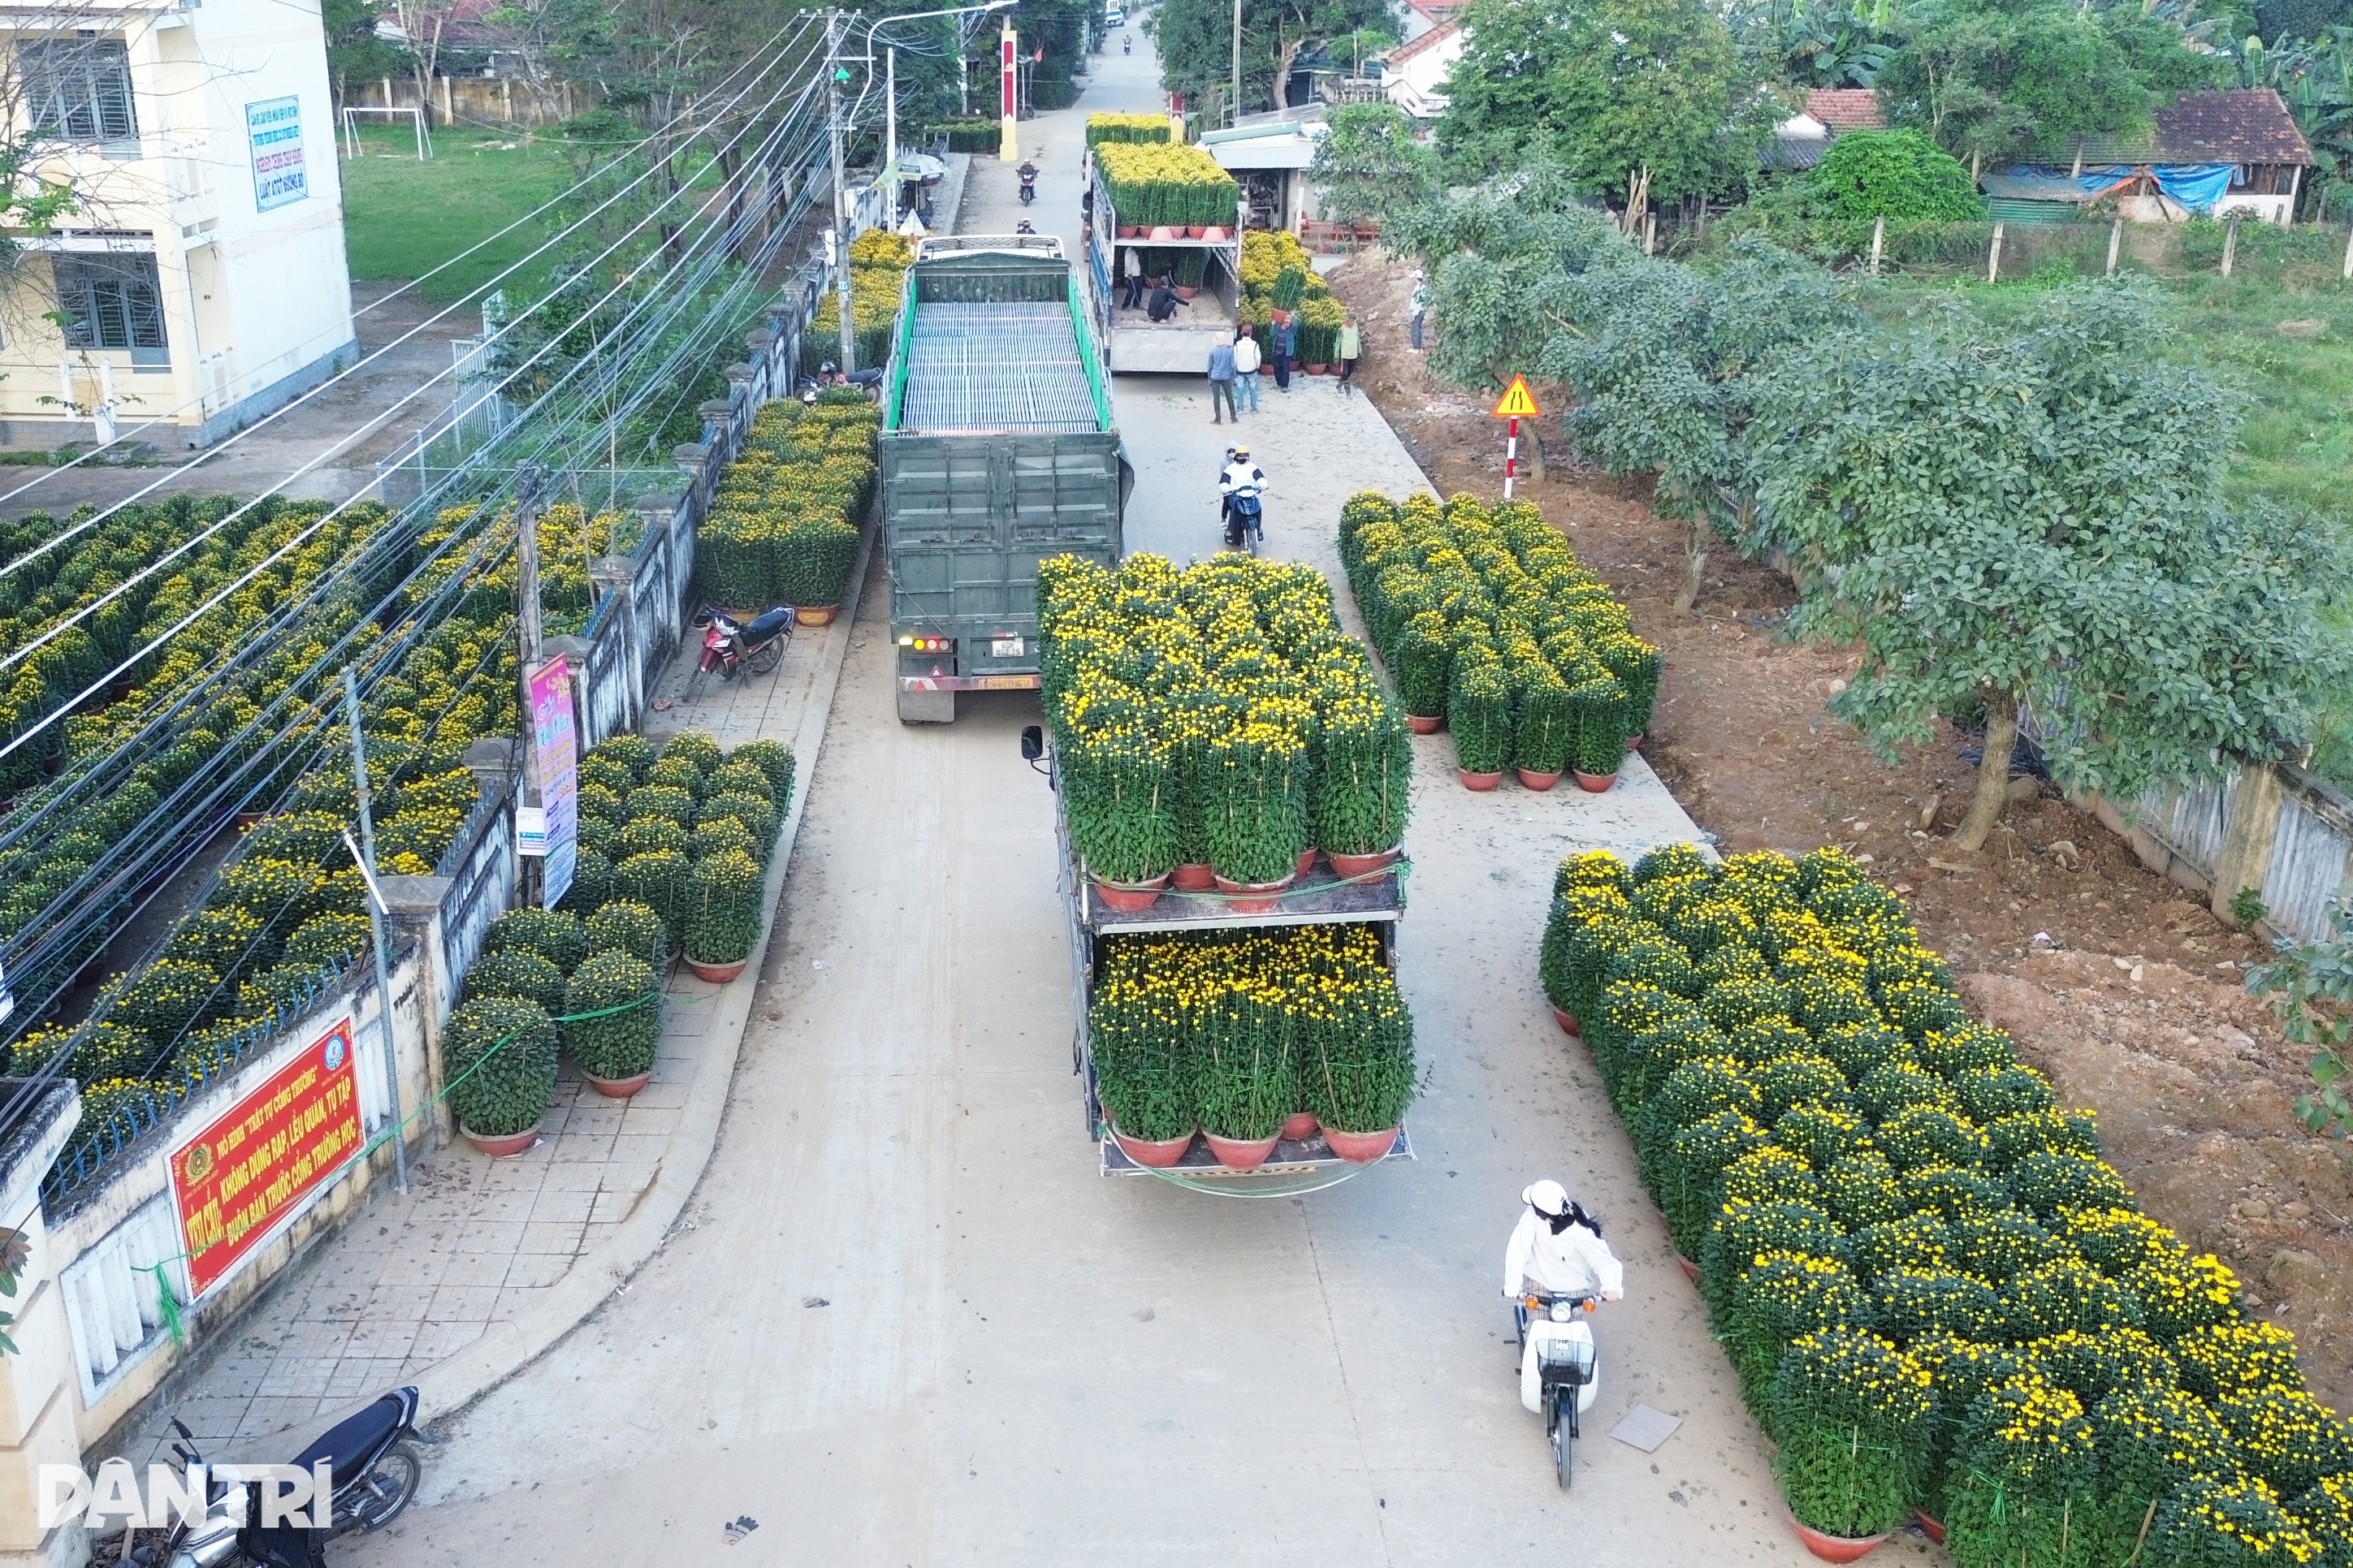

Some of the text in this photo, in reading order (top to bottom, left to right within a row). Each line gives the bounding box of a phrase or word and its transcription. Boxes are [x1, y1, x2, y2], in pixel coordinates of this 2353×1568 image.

[216, 1134, 228, 1160] MÔ
[273, 1084, 292, 1113] CỔNG
[219, 1161, 250, 1205] KHÔNG
[270, 1129, 290, 1164] RẠP,
[288, 1108, 305, 1146] LỀU
[304, 1095, 327, 1133] QUÁN,
[326, 1087, 338, 1117] TỤ
[336, 1074, 352, 1109] TẬP
[186, 1203, 206, 1262] YÊU
[226, 1207, 251, 1248] BUÔN
[249, 1191, 267, 1228] BÁN
[265, 1168, 292, 1212] TRƯỚC
[291, 1149, 314, 1190] CỔNG
[311, 1130, 342, 1172] TRƯỜNG
[340, 1115, 357, 1148] HỌC
